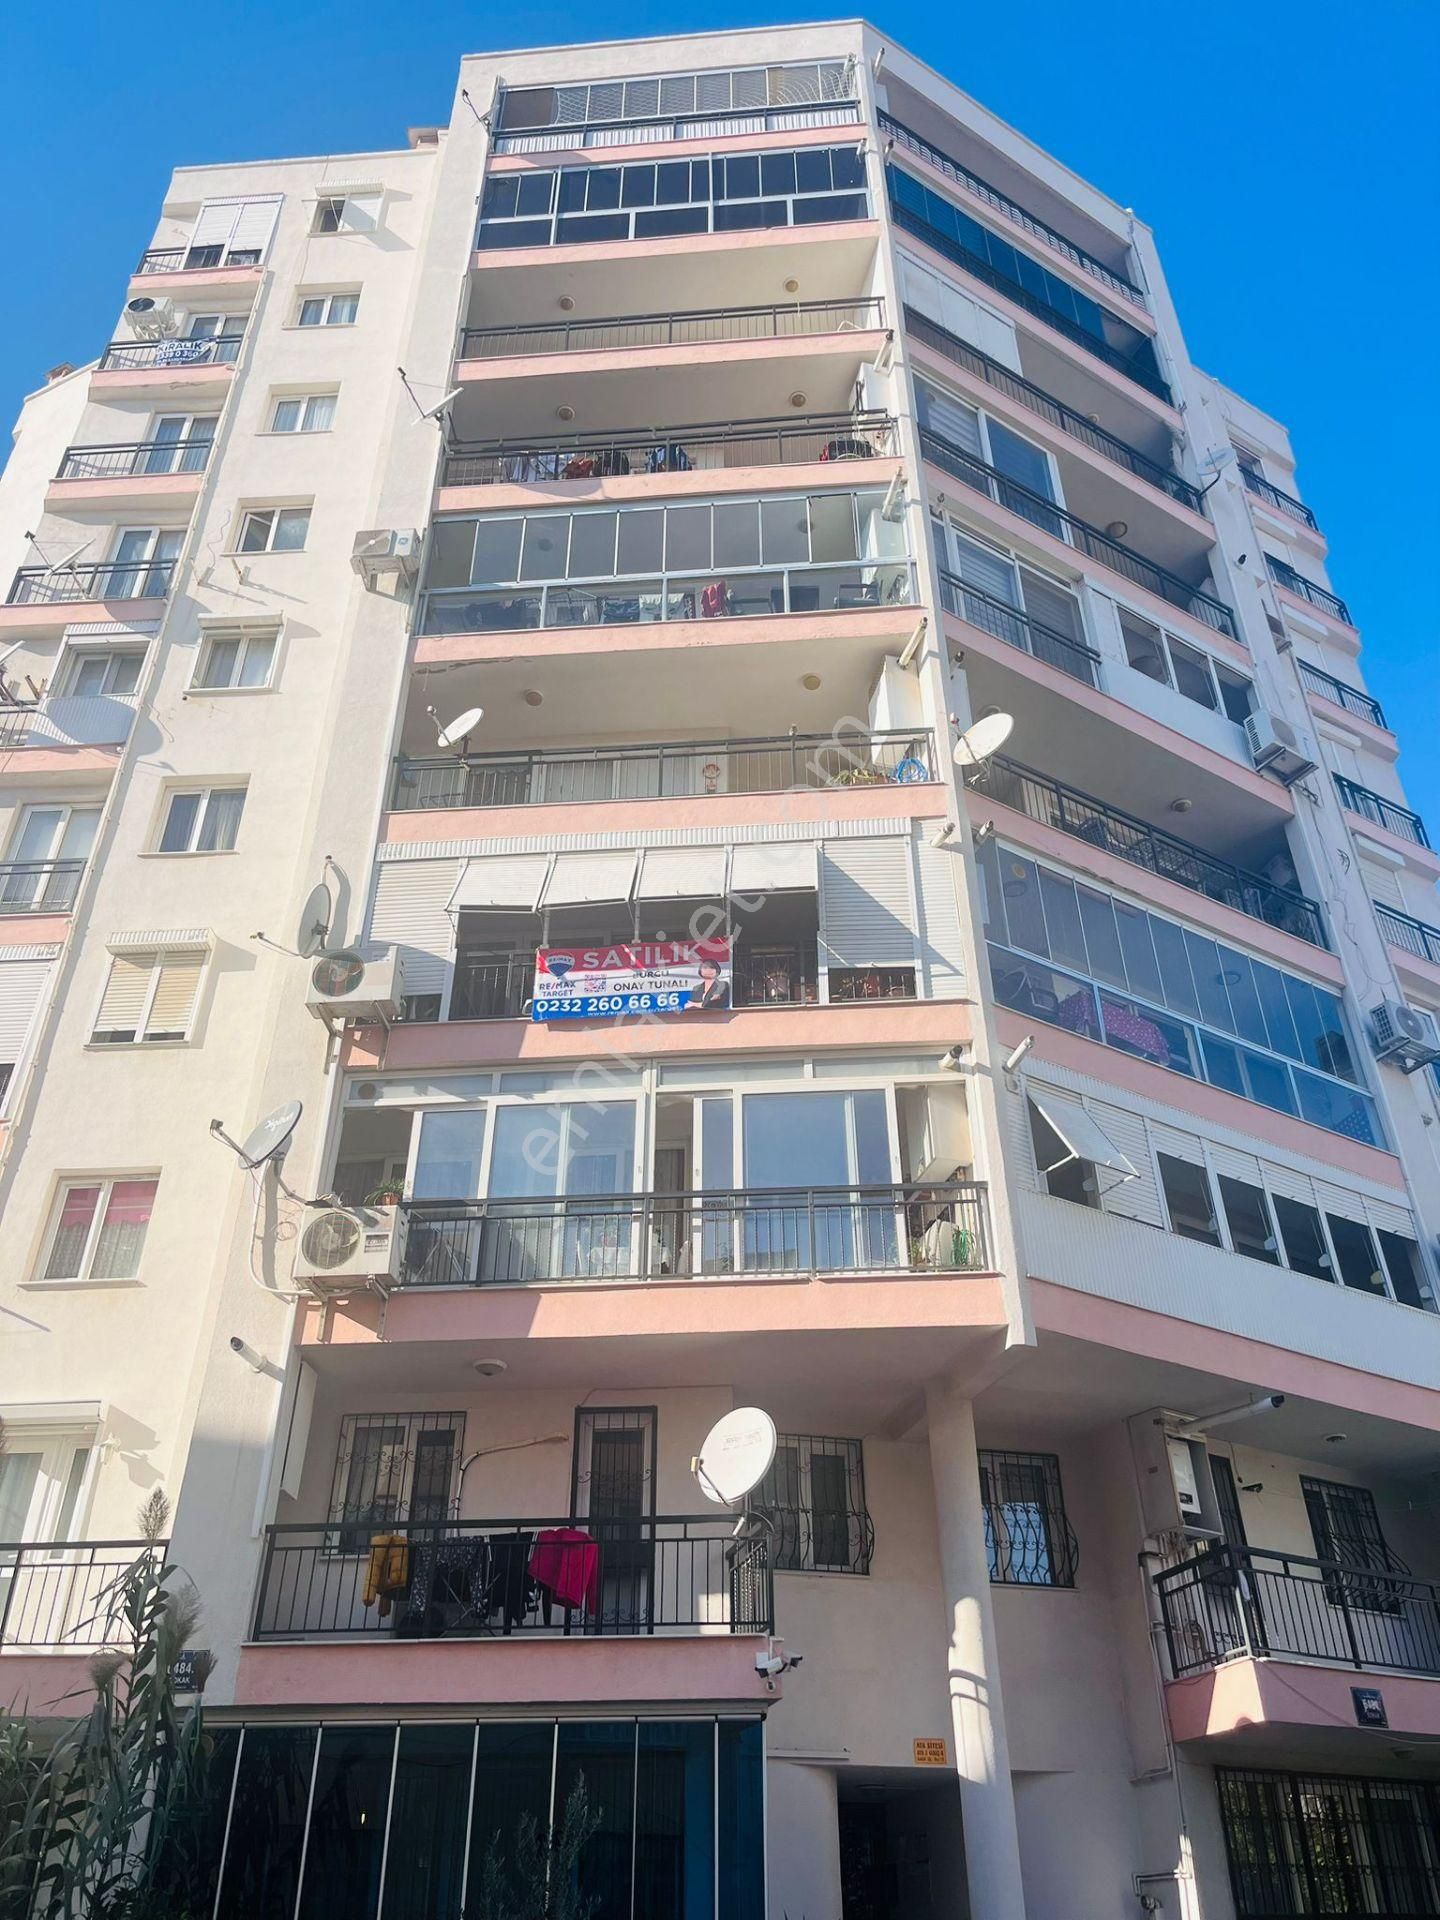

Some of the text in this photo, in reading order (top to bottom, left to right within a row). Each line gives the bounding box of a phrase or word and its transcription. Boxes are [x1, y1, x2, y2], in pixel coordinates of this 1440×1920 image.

[583, 945, 701, 968] SATILIK
[539, 980, 576, 990] RE/MAX
[613, 979, 688, 991] ONAY TUNALI
[542, 989, 574, 997] TARGET
[536, 992, 680, 1013] 0232 260 66 66
